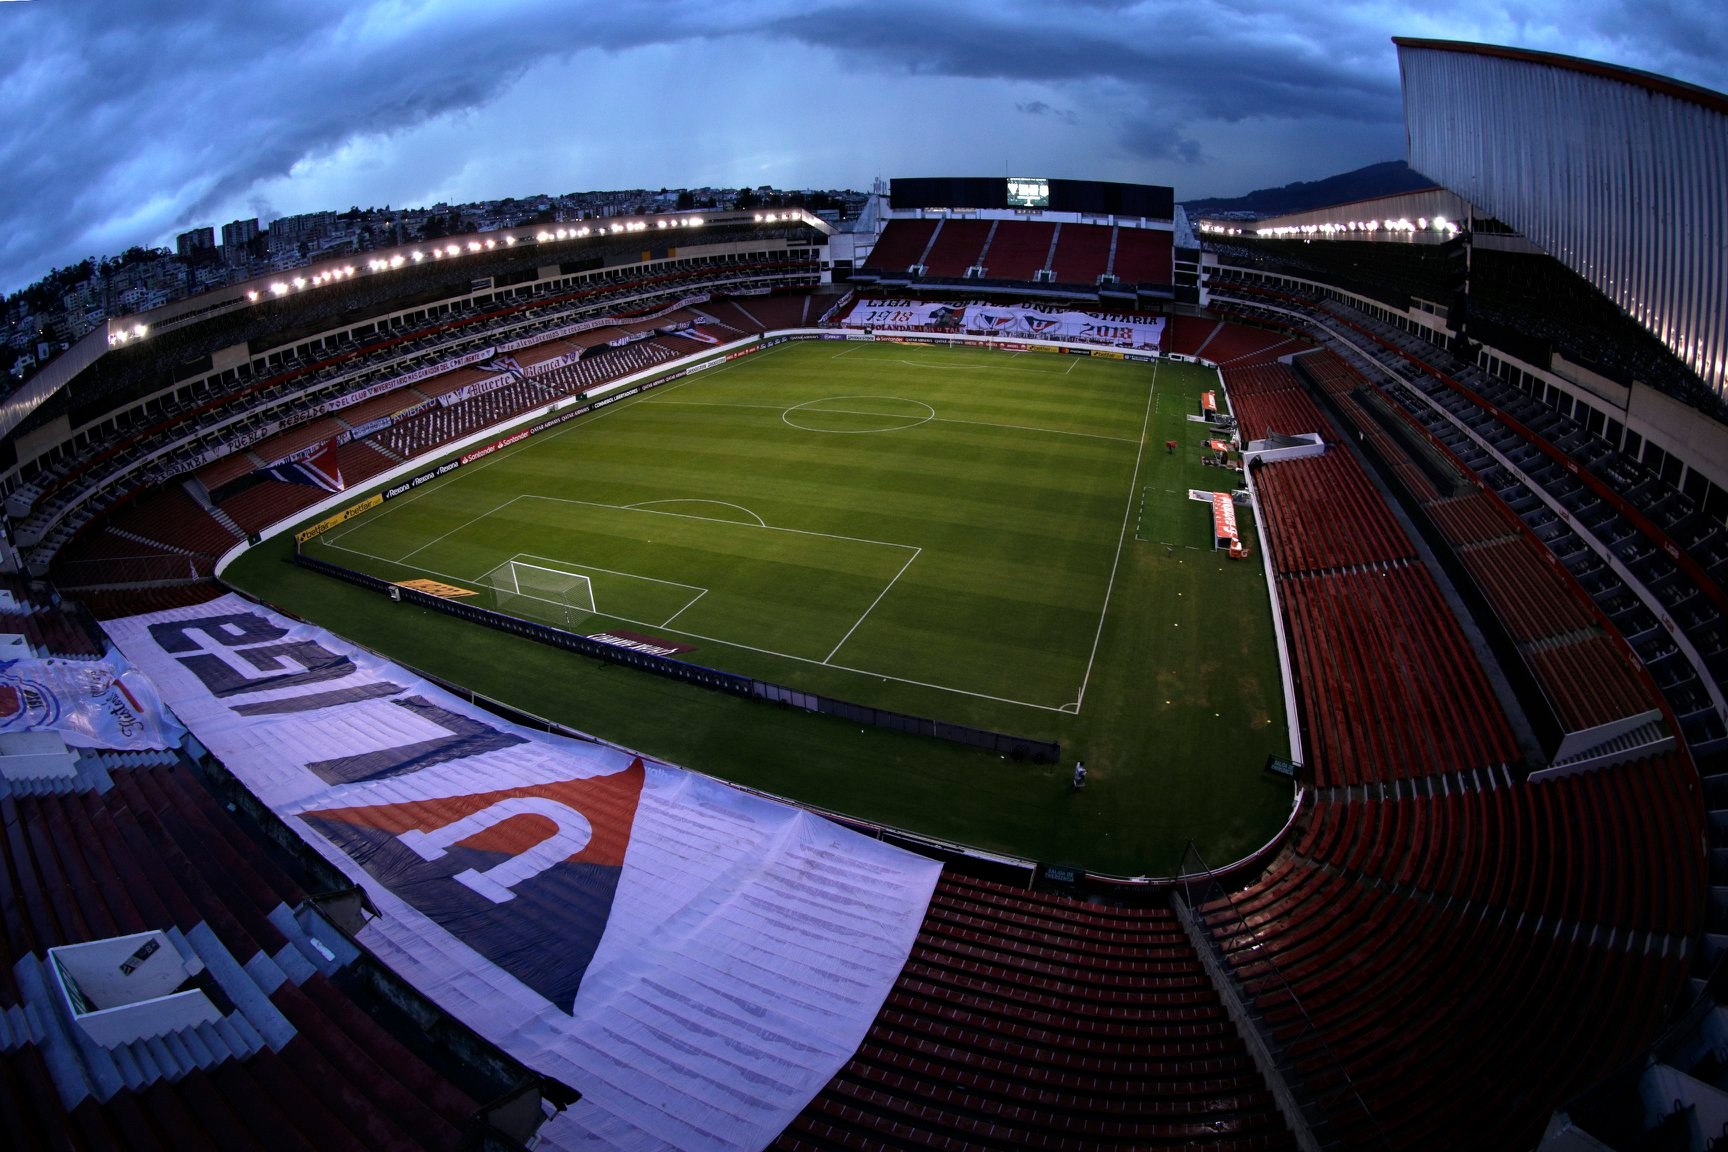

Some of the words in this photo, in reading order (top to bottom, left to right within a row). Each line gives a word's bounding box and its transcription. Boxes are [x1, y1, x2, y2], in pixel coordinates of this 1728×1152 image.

[866, 310, 913, 322] 1918
[1080, 323, 1134, 340] 2018
[530, 424, 544, 434] QATAR
[544, 418, 561, 429] AIRWAYS
[561, 411, 574, 421] QATAR
[468, 445, 496, 462] Santander
[502, 430, 529, 447] Santander
[390, 483, 411, 498] Rexona
[414, 472, 435, 486] Rexona
[439, 460, 459, 475] Rexona
[349, 500, 372, 517] betfair
[305, 521, 330, 539] betfair
